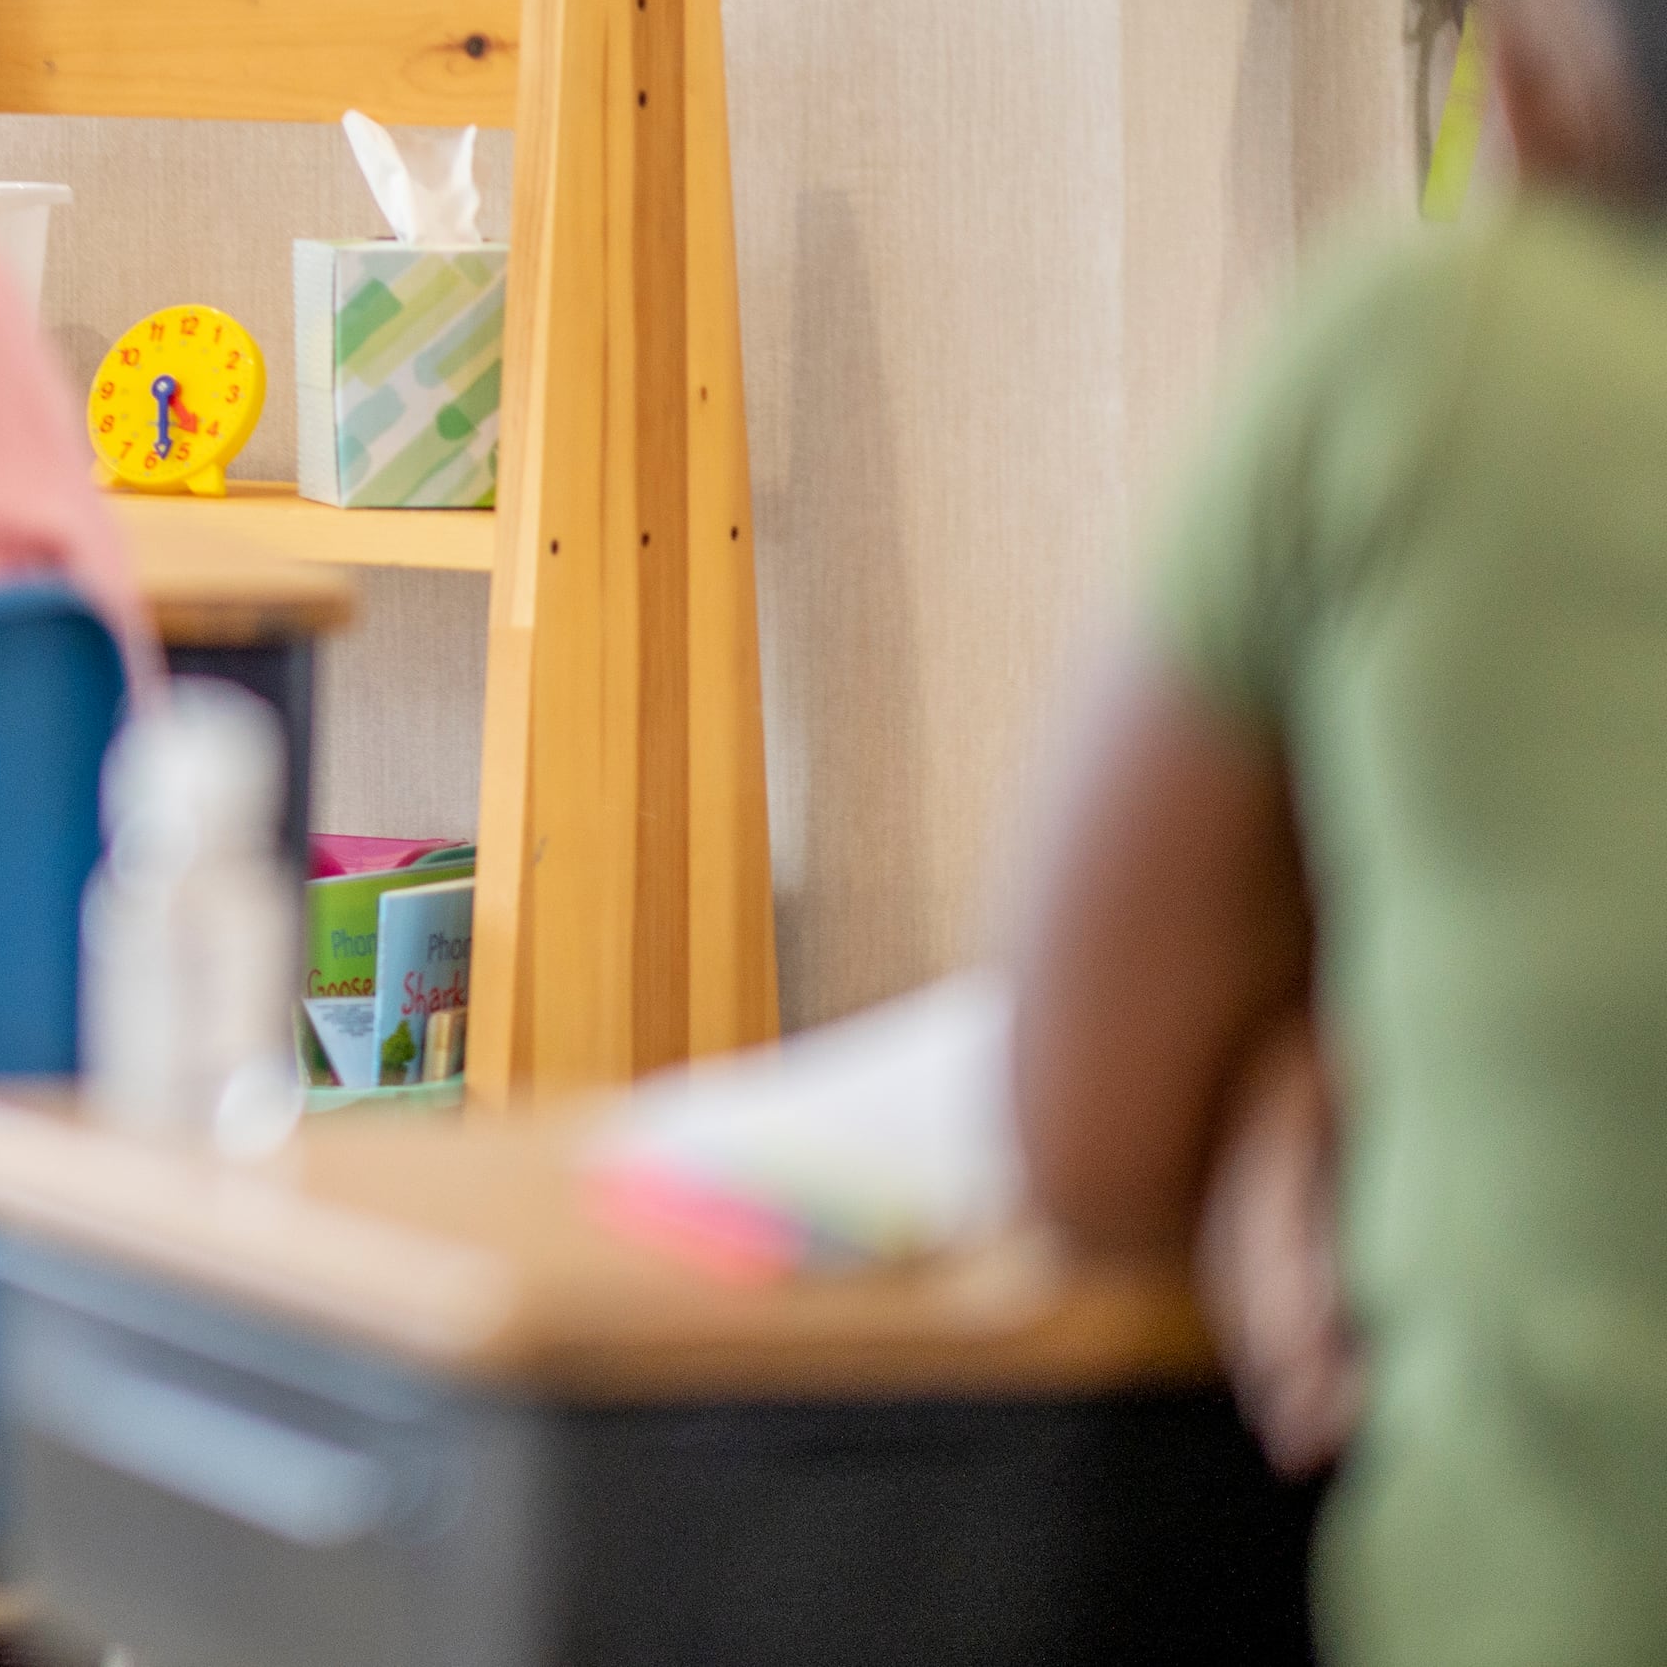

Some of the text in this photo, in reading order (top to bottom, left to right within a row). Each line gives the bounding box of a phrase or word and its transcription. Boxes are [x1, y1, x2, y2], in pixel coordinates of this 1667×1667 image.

[150, 324, 165, 340] 11
[180, 318, 199, 336] 12
[213, 327, 222, 343] 1
[120, 349, 140, 365] 10
[225, 352, 240, 369] 2
[100, 383, 115, 399] 9
[225, 386, 239, 404] 3
[100, 416, 114, 432] 8
[207, 422, 219, 437] 4
[121, 443, 132, 459] 7
[176, 444, 190, 460] 5
[145, 452, 158, 469] 6
